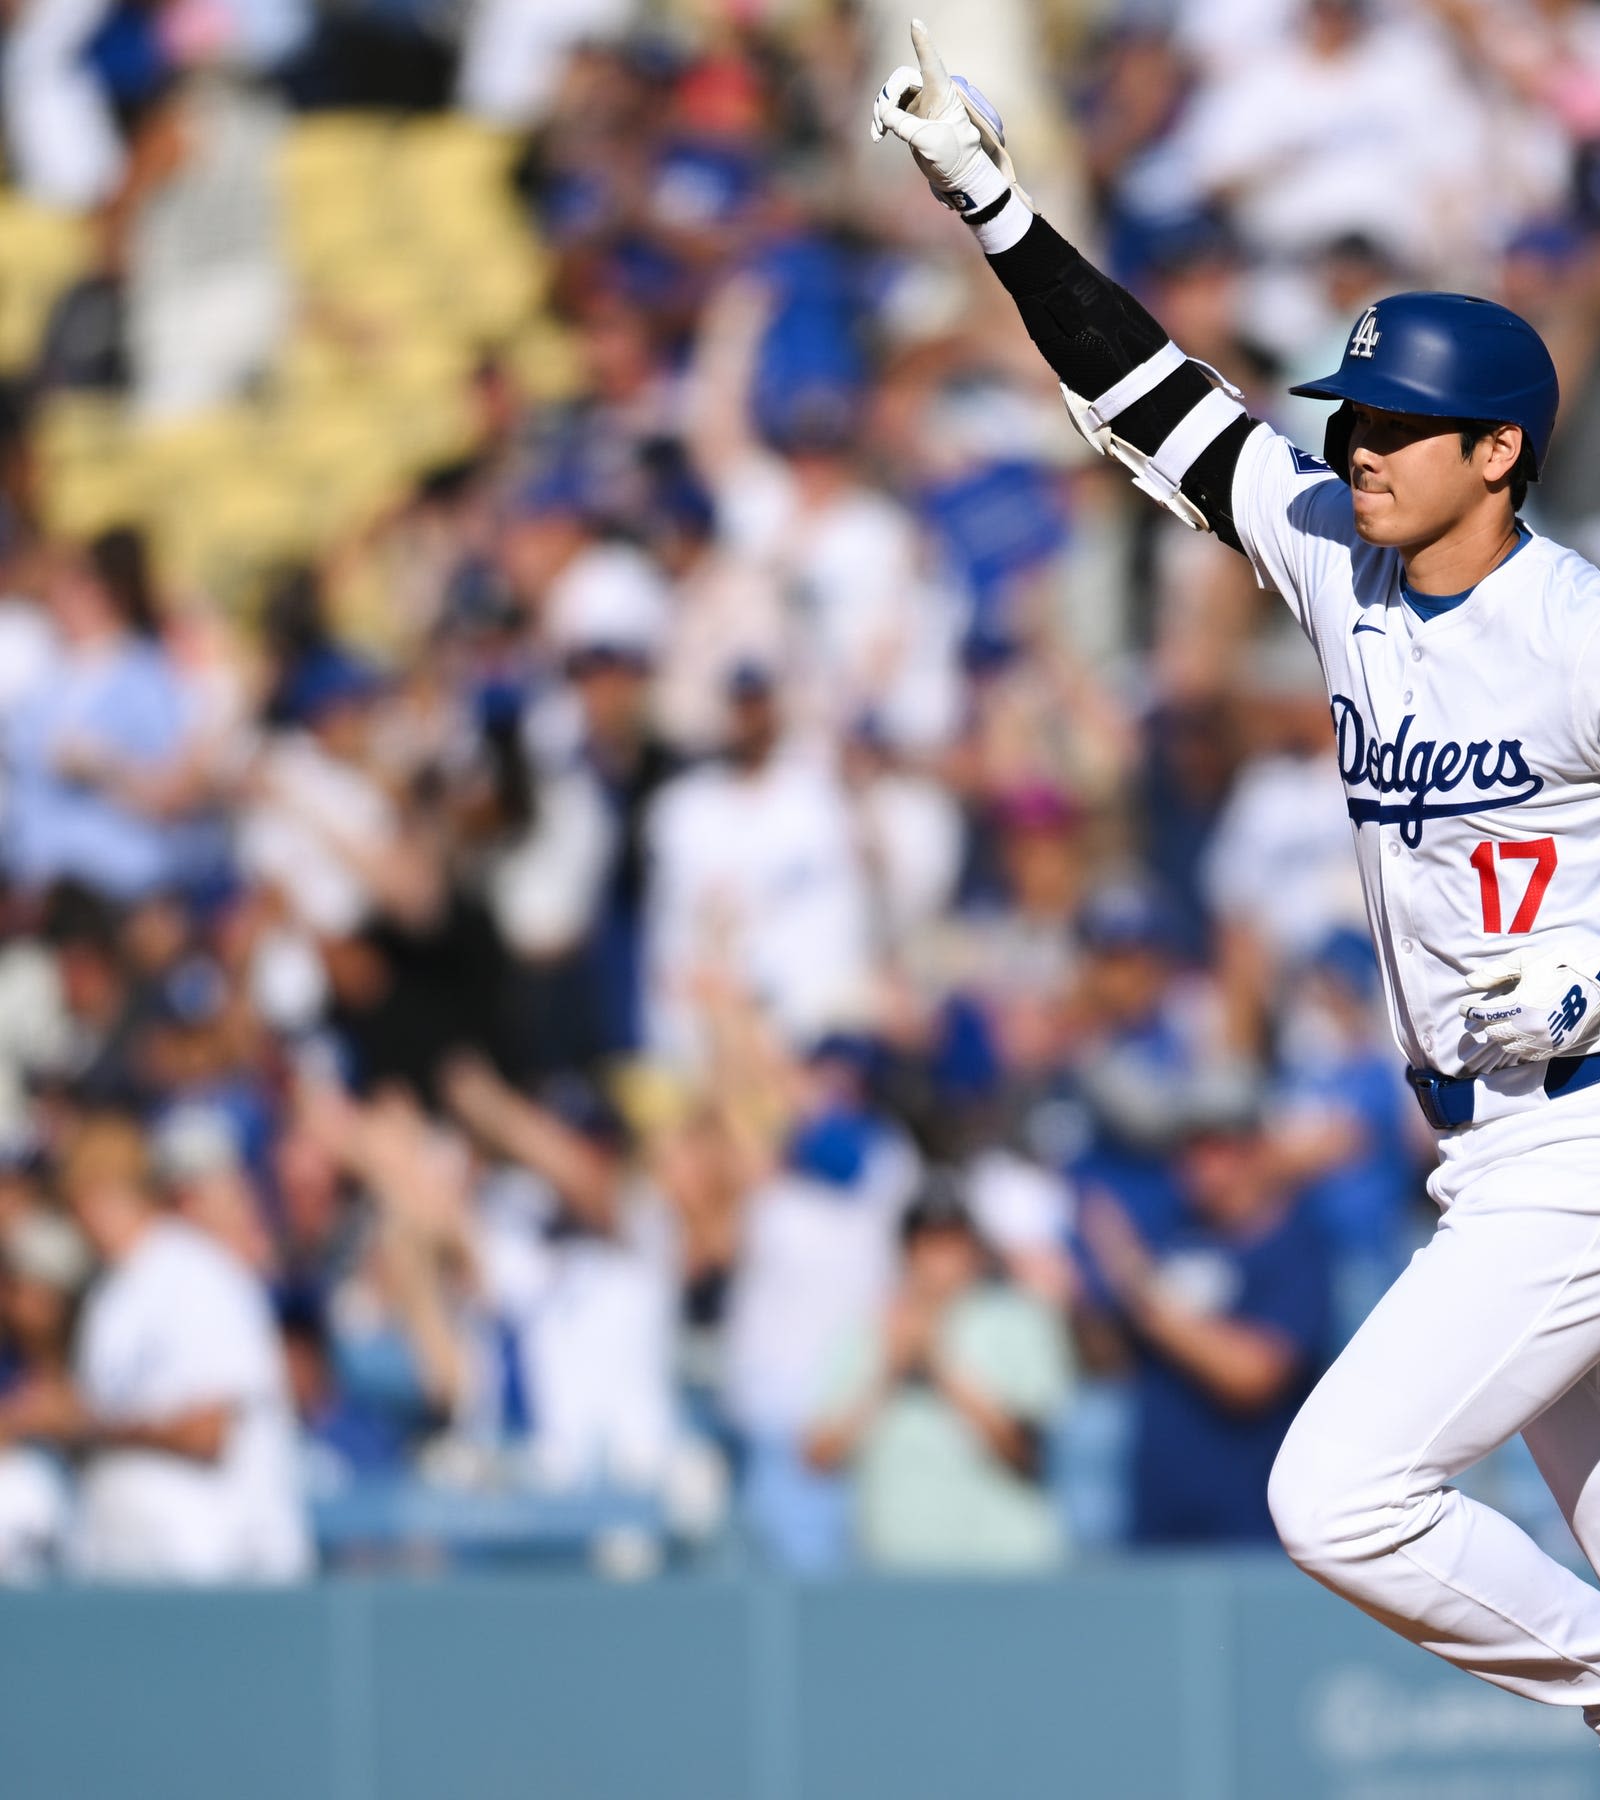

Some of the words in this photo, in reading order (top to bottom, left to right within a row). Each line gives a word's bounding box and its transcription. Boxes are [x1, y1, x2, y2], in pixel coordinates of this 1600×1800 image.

[1350, 306, 1380, 358] LA
[1331, 694, 1544, 849] Dodgers
[1470, 837, 1558, 934] 17
[1487, 1007, 1522, 1021] balance
